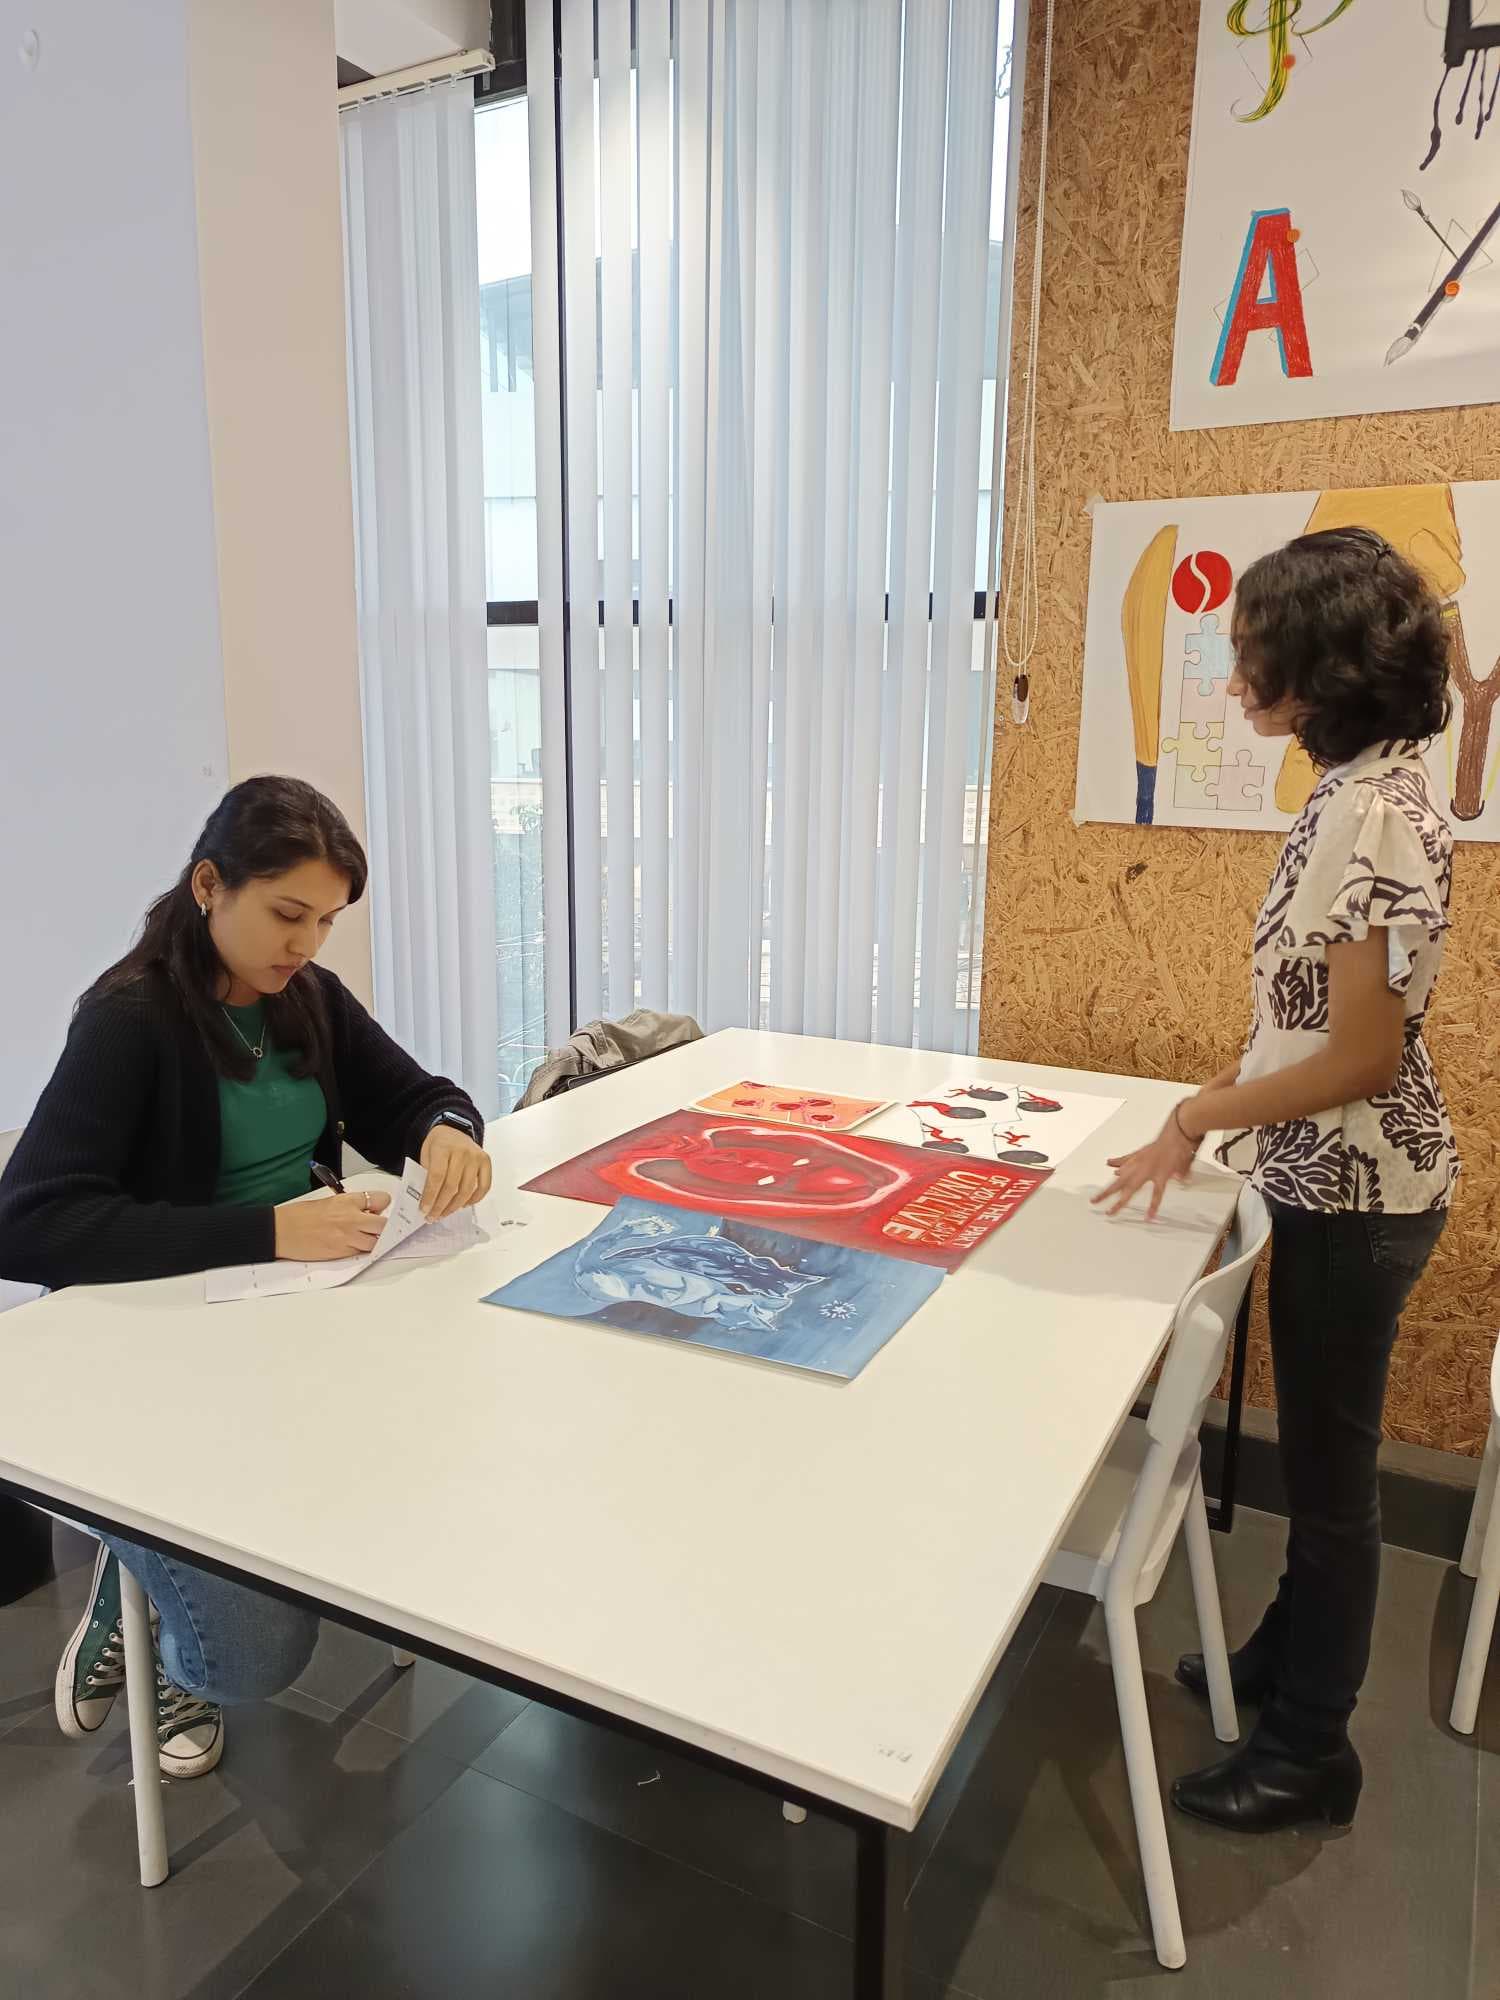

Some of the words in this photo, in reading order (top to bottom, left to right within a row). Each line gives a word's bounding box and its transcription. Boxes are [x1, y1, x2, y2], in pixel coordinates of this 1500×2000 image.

[1209, 208, 1313, 386] A
[987, 1174, 1012, 1188] OF
[882, 1170, 988, 1240] UNALIVE
[977, 1202, 1015, 1222] THE
[951, 1225, 988, 1249] PART
